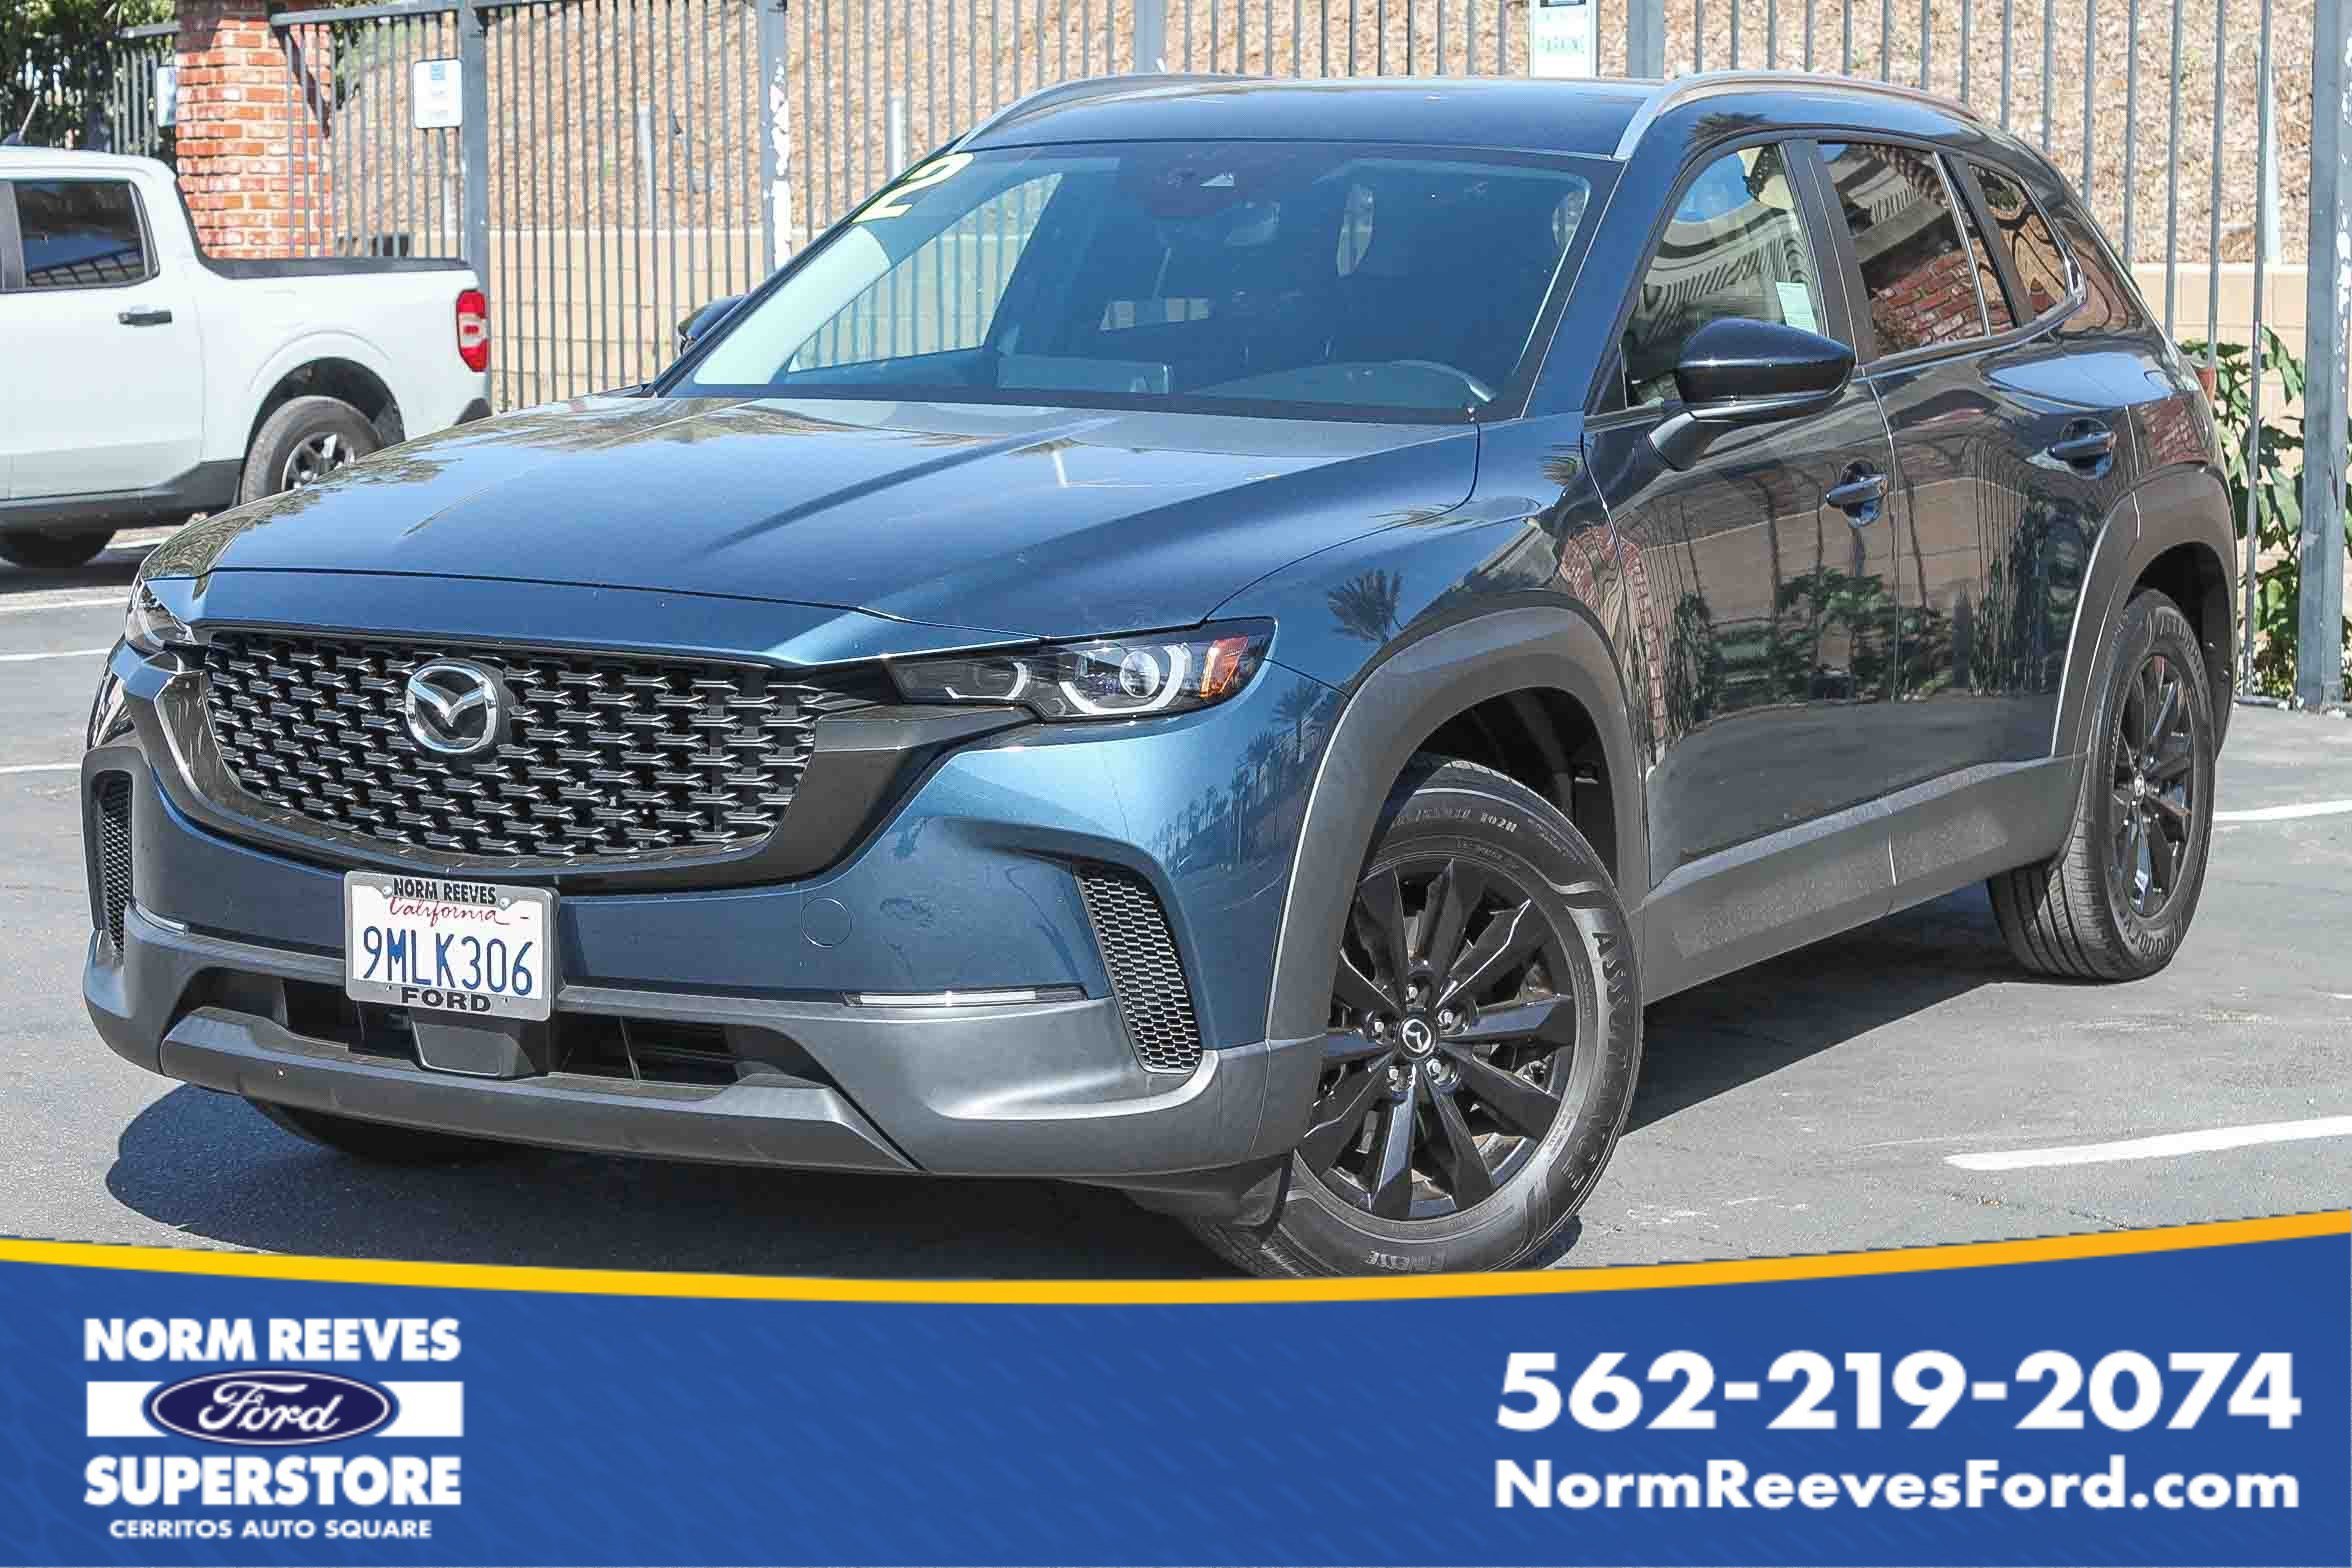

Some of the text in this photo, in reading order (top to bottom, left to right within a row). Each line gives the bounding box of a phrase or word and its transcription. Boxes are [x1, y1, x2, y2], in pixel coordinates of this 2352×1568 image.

[393, 877, 497, 905] NORM REEVES
[389, 896, 511, 927] California
[363, 926, 533, 996] 9MLK306
[400, 986, 492, 1012] FORD
